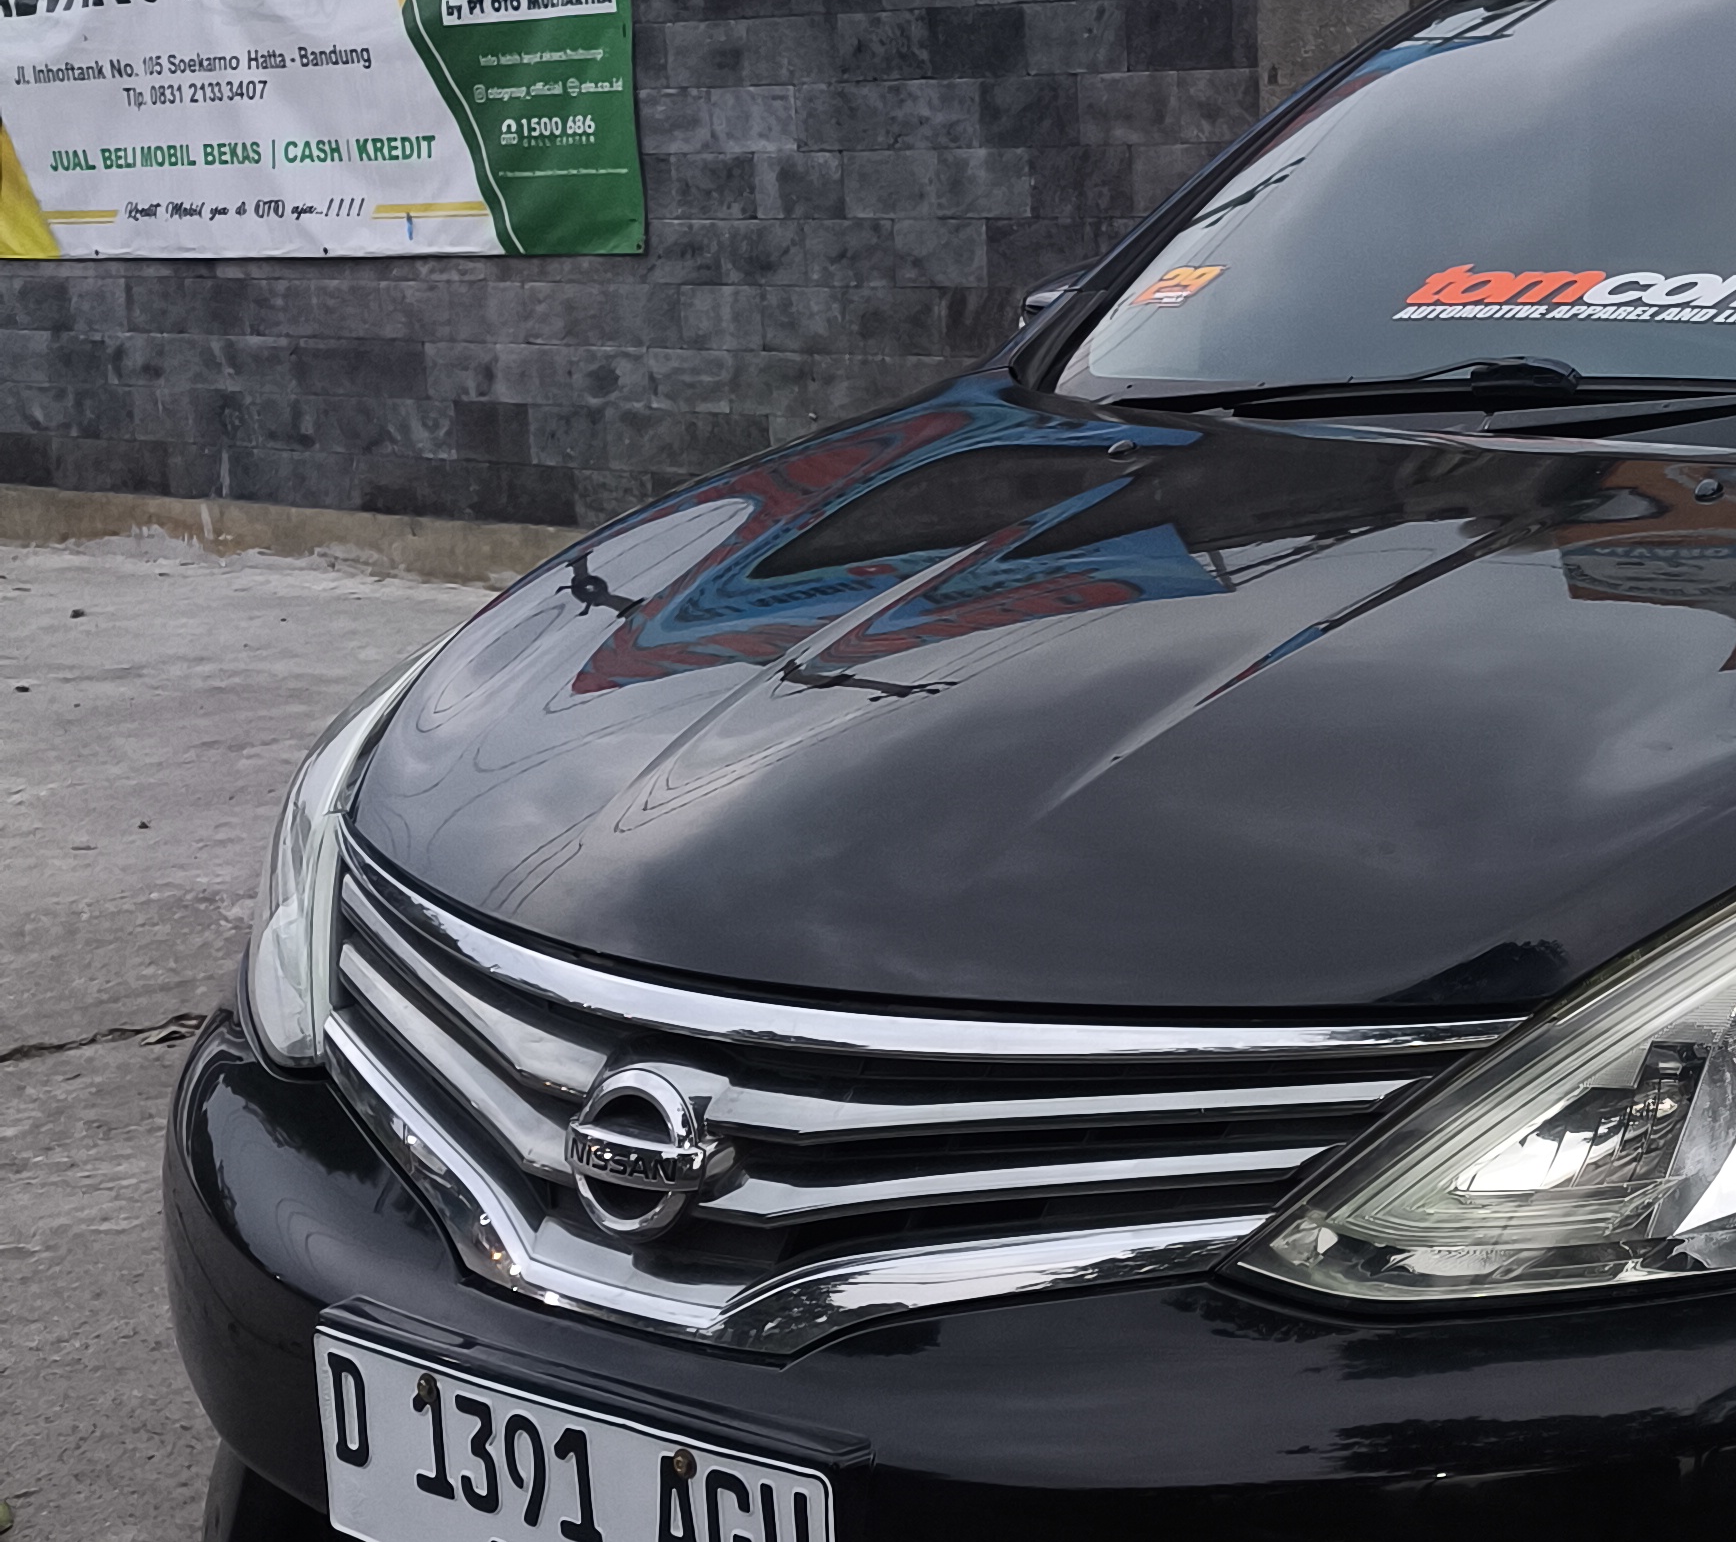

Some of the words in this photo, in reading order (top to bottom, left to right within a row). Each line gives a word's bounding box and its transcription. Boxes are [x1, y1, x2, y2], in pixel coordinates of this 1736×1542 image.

[247, 48, 287, 71] Hatta
[299, 45, 372, 69] Bandung
[150, 84, 183, 106] 0831
[226, 79, 268, 102] 3407
[521, 117, 562, 136] 1500
[567, 114, 595, 134] 686
[50, 149, 96, 172] JUAL
[140, 144, 197, 168] MOBIL
[203, 141, 262, 165] BEKAS
[283, 139, 343, 163] CASH
[355, 134, 436, 162] KREDIT
[1392, 305, 1549, 320] AUTOMOTIVE
[1546, 305, 1659, 321] APPAREL
[1654, 307, 1718, 322] AND
[570, 1136, 679, 1183] NISSAN
[328, 1352, 369, 1467] D
